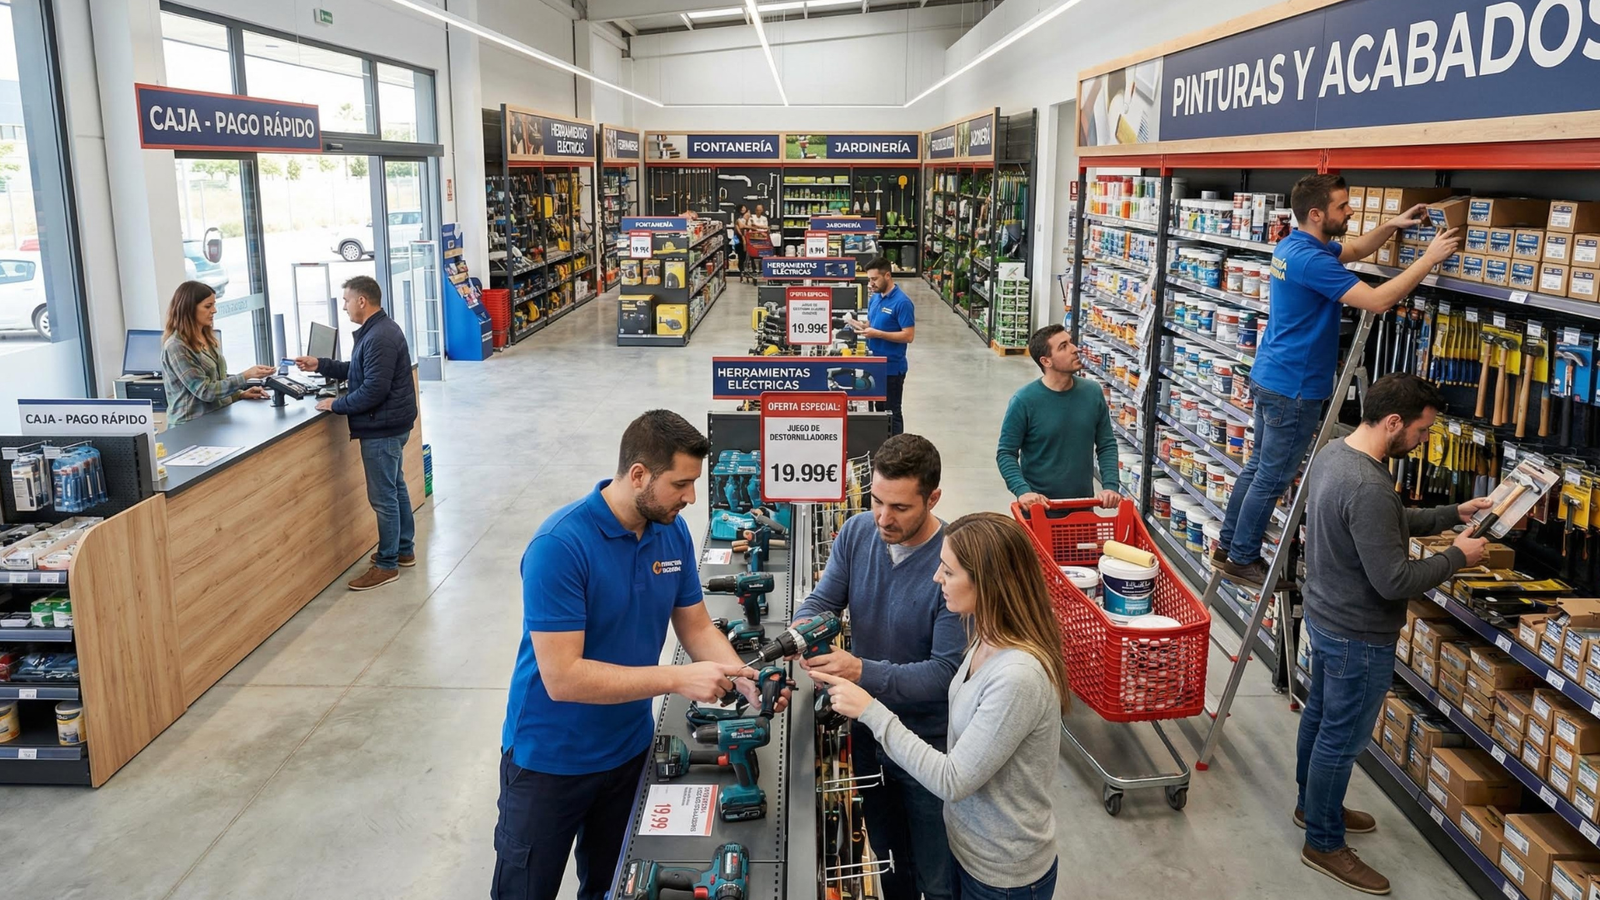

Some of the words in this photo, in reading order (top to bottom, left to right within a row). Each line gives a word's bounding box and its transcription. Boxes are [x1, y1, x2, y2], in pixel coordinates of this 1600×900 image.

[1172, 53, 1286, 118] PINTURAS
[1293, 46, 1316, 100] Y
[150, 105, 201, 132] CAJA
[215, 111, 259, 136] PAGO
[264, 111, 314, 138] RÁPIDO
[693, 139, 773, 153] FONTANERÍA
[834, 139, 911, 153] JARDINERÍA
[772, 267, 812, 275] ELÉCTRICAS
[792, 323, 828, 334] 19.99€
[717, 367, 811, 378] HERRAMIENTAS
[728, 377, 799, 390] ELÉCTRICAS
[768, 402, 799, 411] OFERTA
[800, 402, 841, 411] ESPECIAL:
[25, 414, 56, 424] CAJA
[66, 415, 99, 425] PAGO
[101, 412, 148, 425] RÁPIDO
[771, 463, 838, 482] 19.99€
